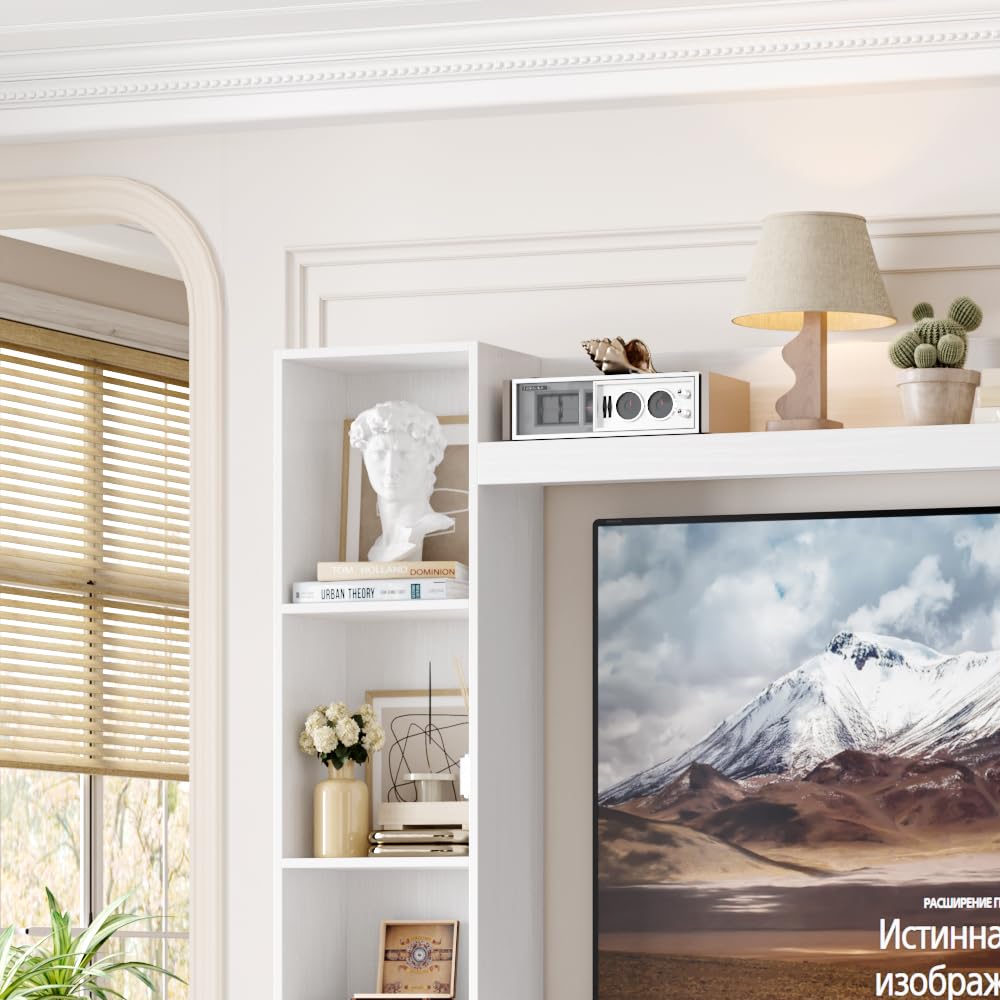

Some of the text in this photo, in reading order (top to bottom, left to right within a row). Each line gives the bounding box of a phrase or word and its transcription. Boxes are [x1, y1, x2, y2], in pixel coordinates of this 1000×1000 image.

[410, 568, 456, 576] DOMINION
[321, 588, 345, 600] URBAN
[348, 587, 376, 599] THEORY
[923, 896, 992, 909] РАСШИРЕНИЕ
